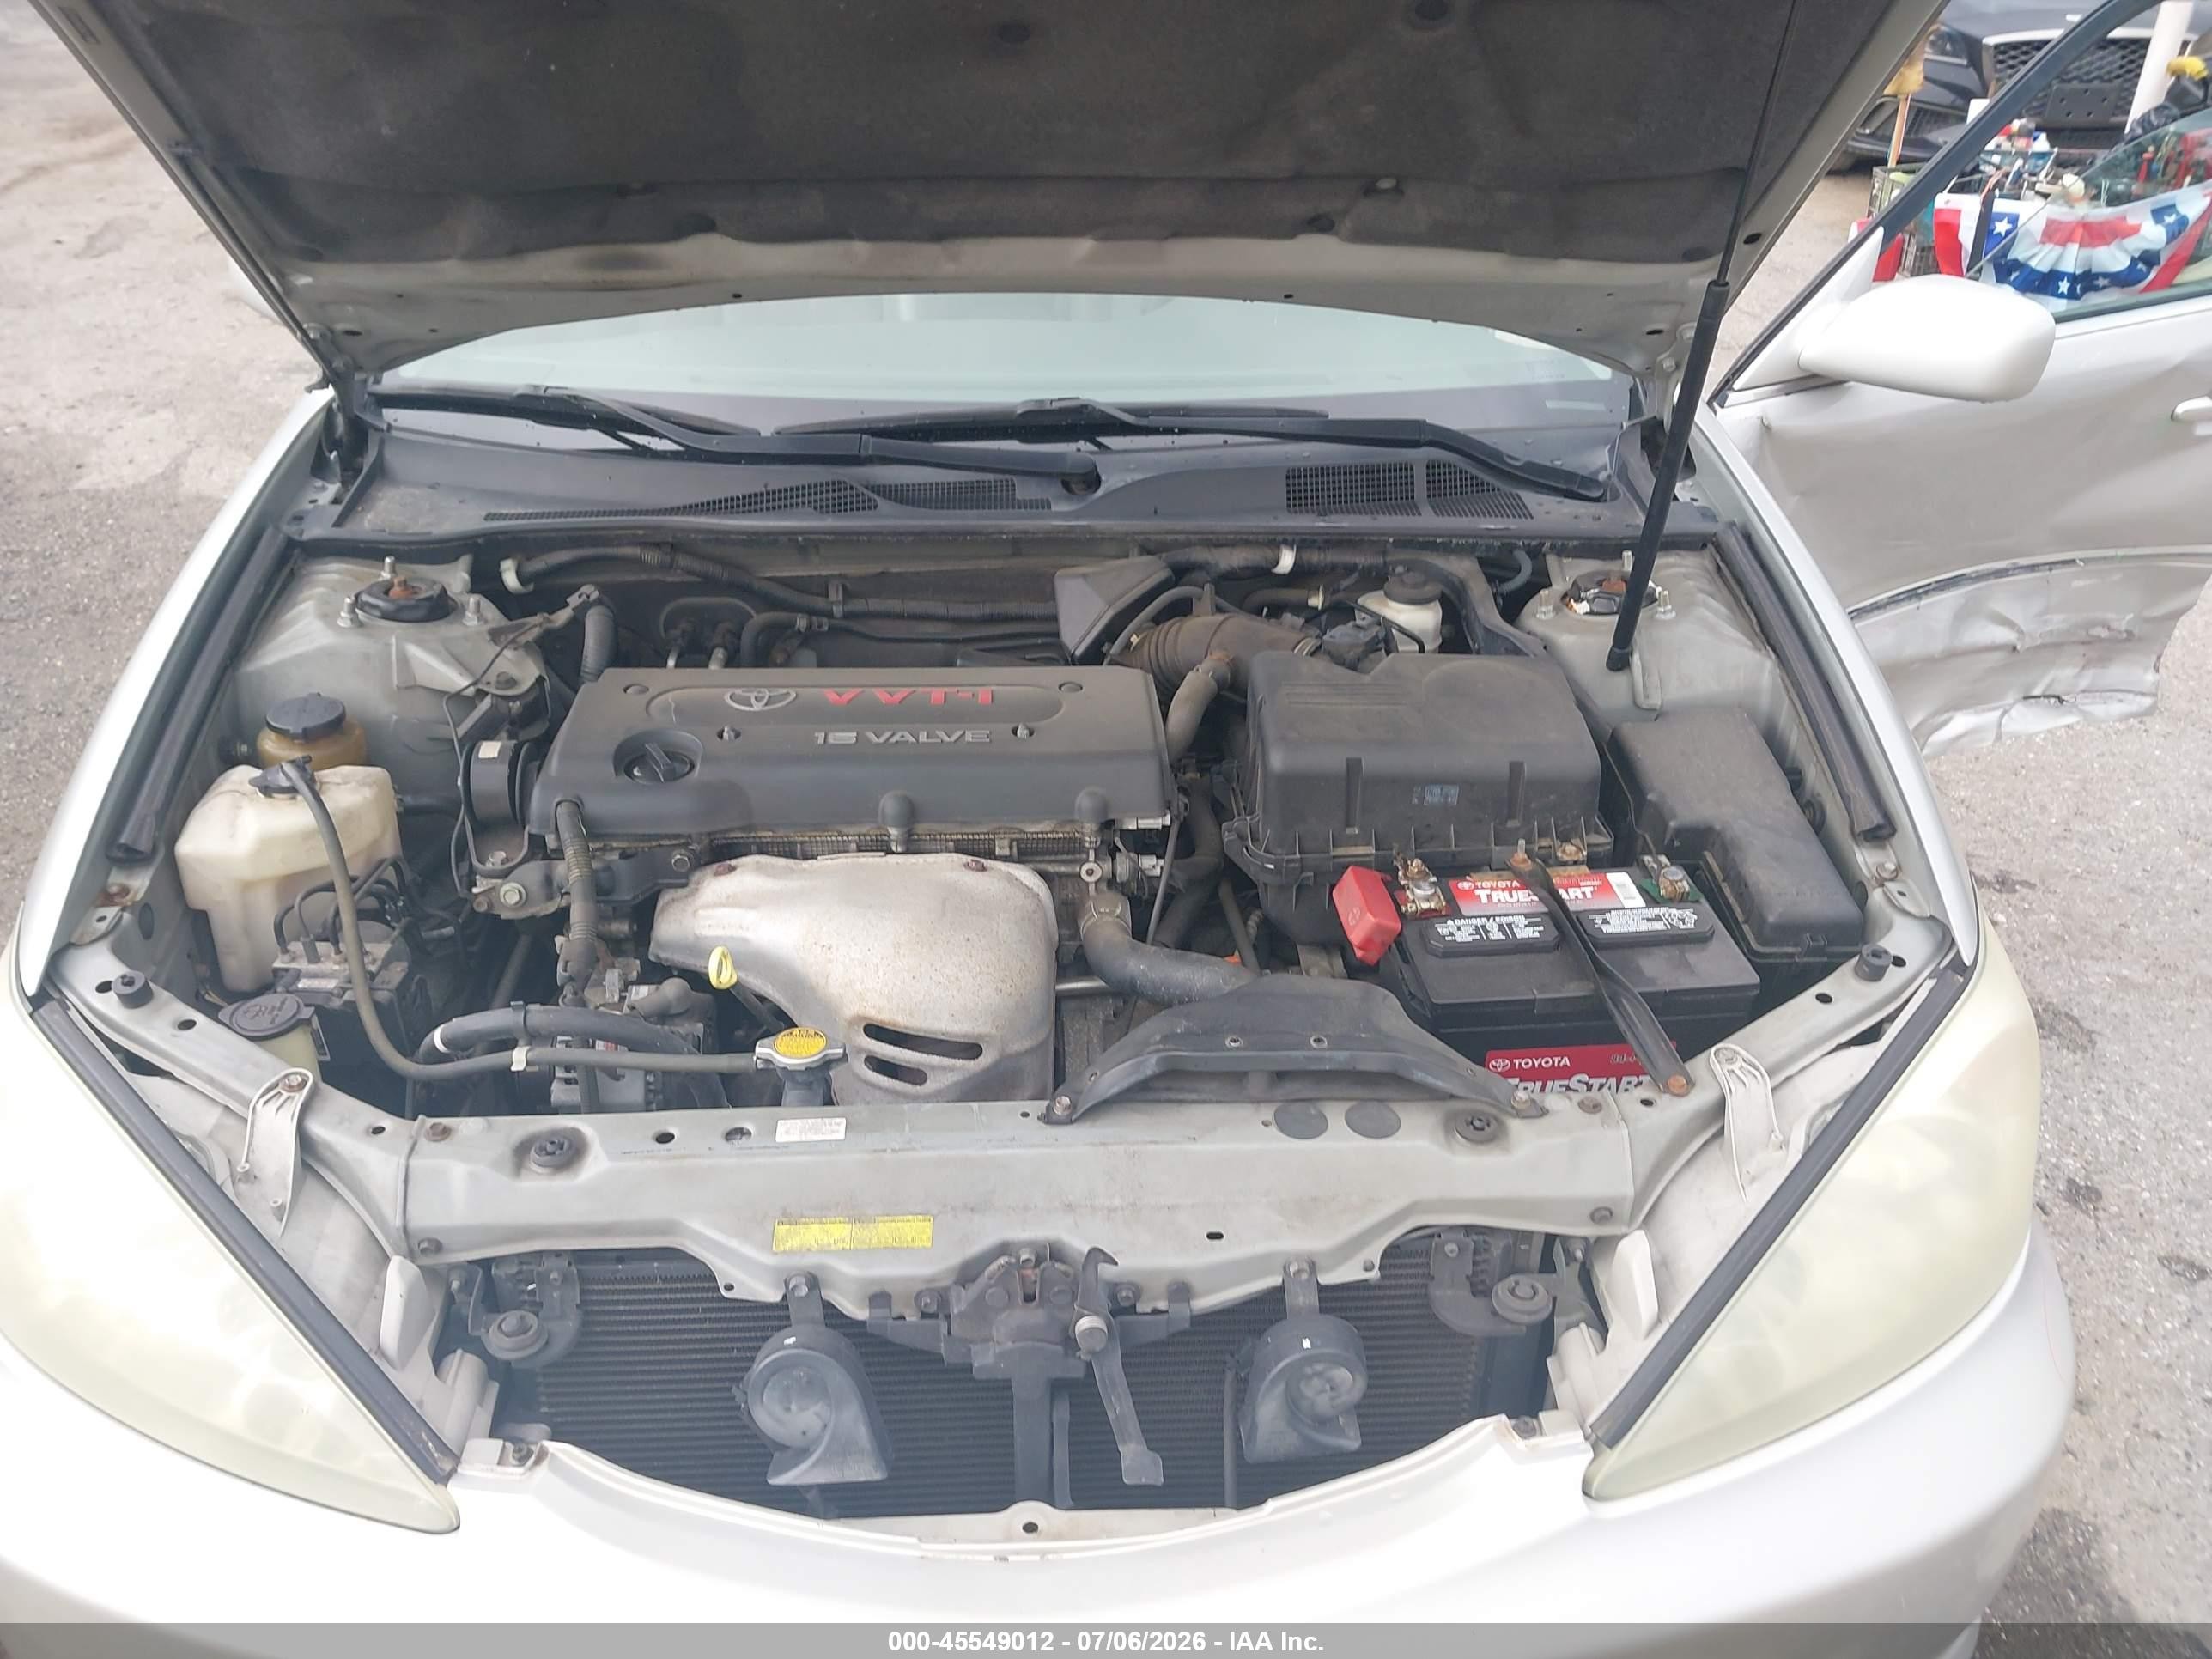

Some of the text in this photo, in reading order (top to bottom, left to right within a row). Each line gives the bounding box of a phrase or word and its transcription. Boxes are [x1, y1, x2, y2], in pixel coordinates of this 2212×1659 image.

[865, 731, 991, 744] VALVE
[1474, 879, 1521, 889] TOYOTA
[1513, 1056, 1571, 1070] TOYOTA
